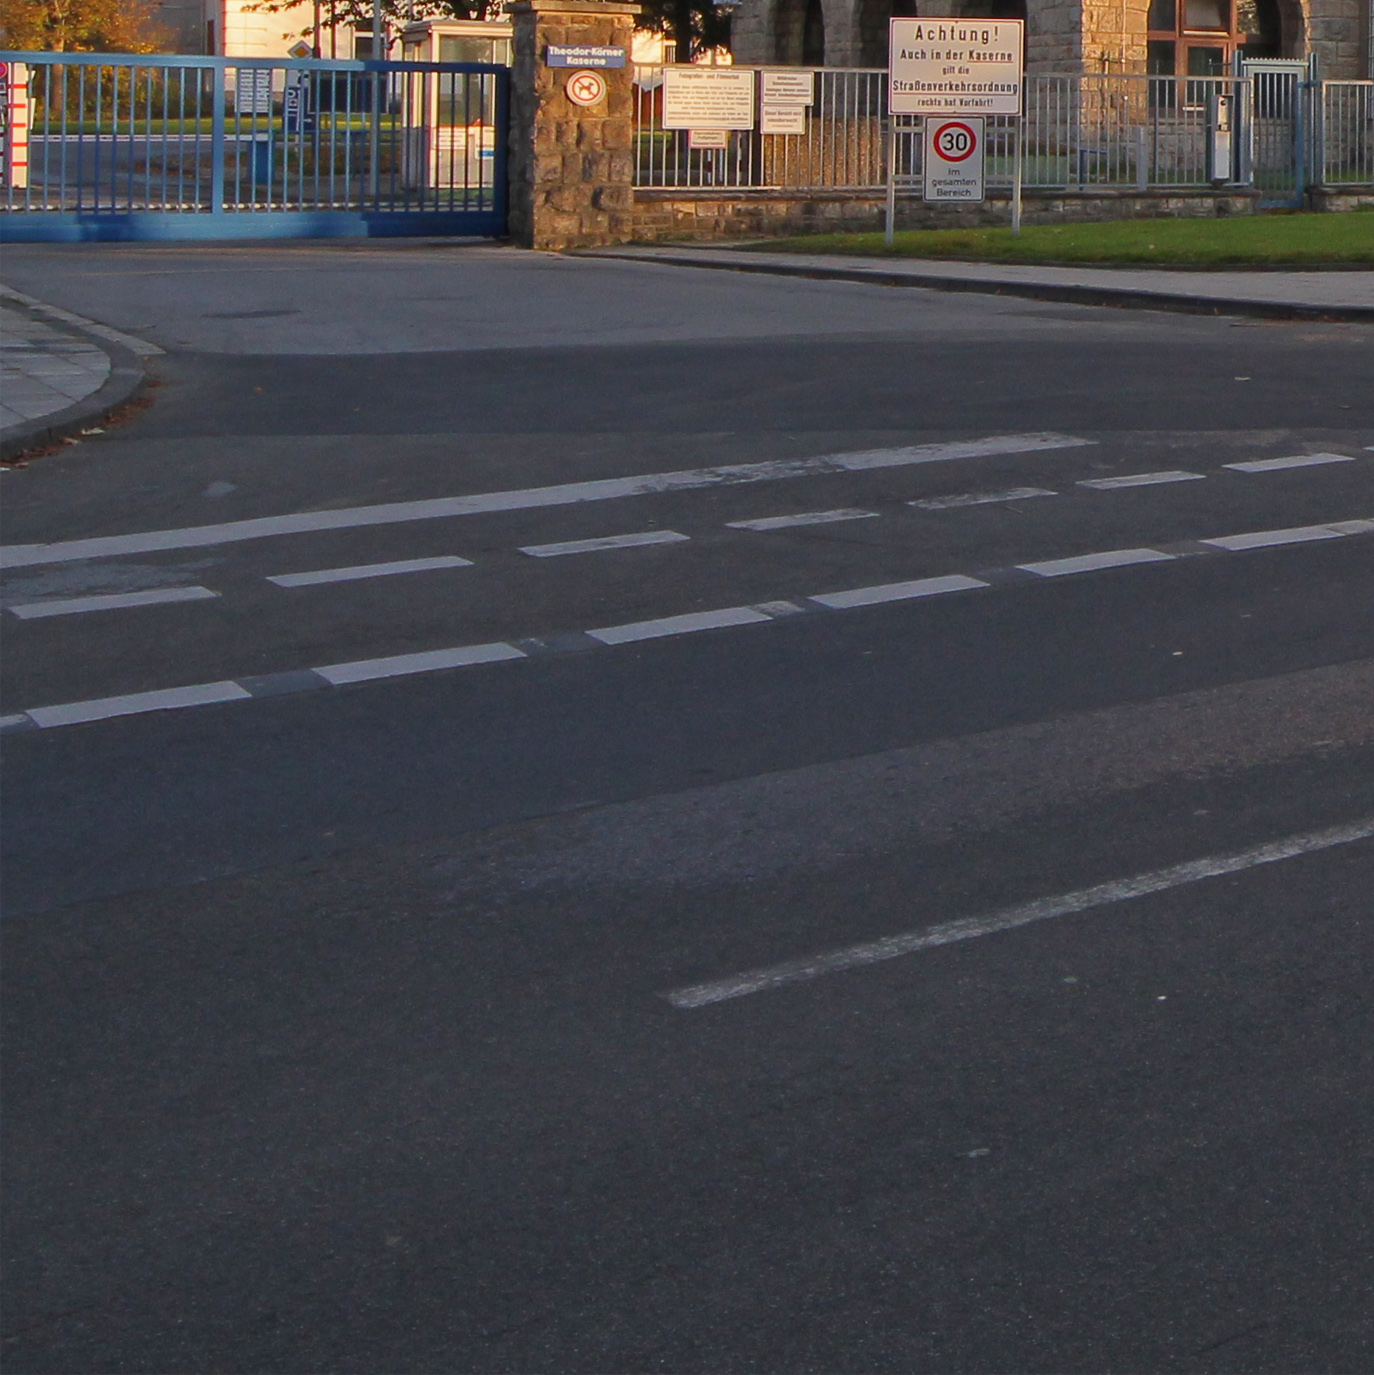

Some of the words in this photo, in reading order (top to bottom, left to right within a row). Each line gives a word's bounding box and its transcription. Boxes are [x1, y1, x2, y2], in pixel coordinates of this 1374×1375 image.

[915, 25, 998, 45] Achtung!
[549, 46, 624, 57] Theodor-Körner
[900, 49, 926, 60] Auch
[931, 49, 941, 60] in
[946, 49, 964, 60] der
[968, 49, 1013, 61] Kaserne
[566, 56, 606, 65] Kaserne
[942, 66, 955, 75] gilt
[958, 66, 970, 74] die
[892, 80, 1018, 94] Straßenverkehrsordnung
[917, 98, 942, 107] rechts
[944, 98, 956, 107] hat
[959, 98, 994, 107] Vorfahrt!
[942, 133, 968, 151] 30
[932, 178, 977, 188] gesamten
[936, 188, 971, 197] Bereich
